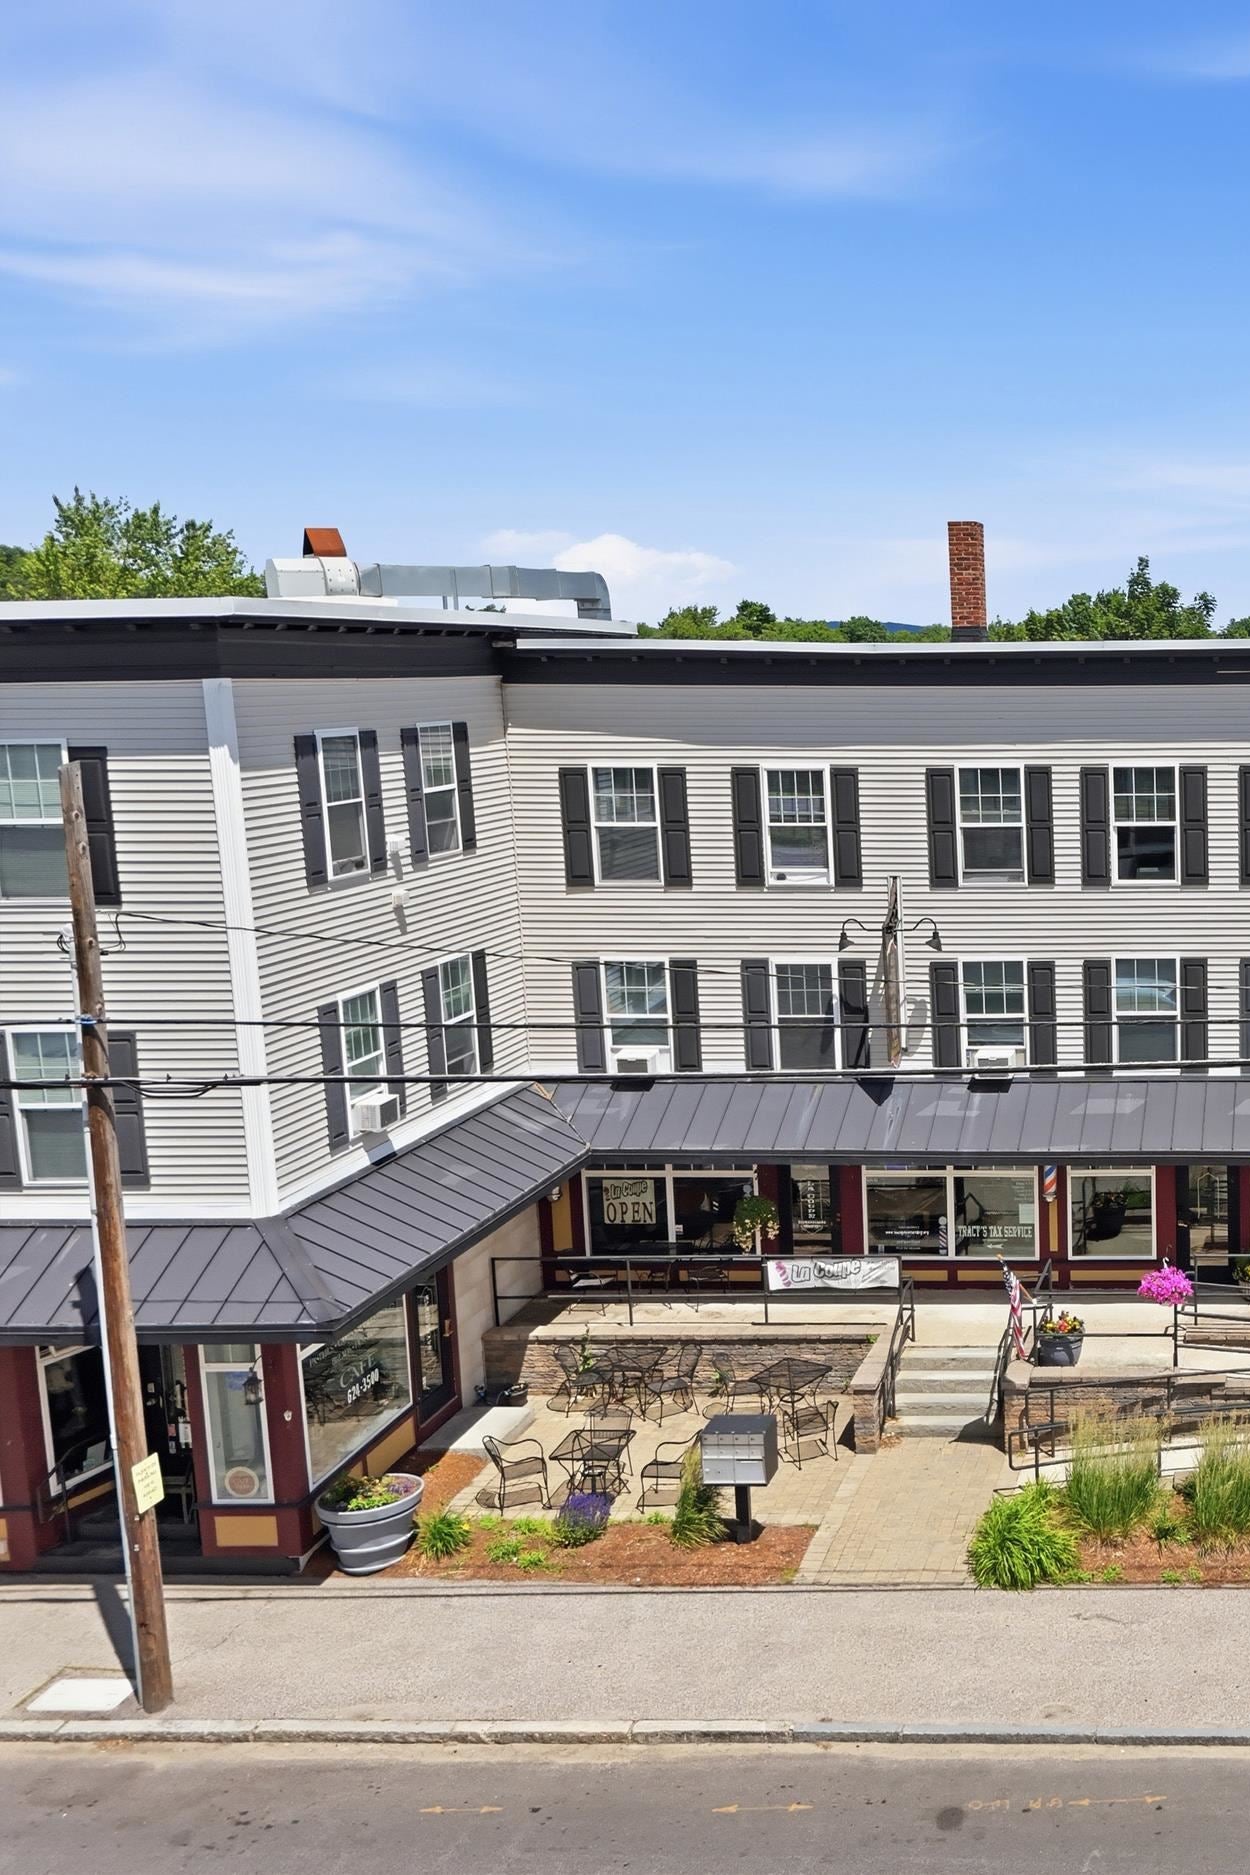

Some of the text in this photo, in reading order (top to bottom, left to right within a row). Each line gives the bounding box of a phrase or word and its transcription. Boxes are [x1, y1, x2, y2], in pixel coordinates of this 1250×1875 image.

[606, 1202, 653, 1223] OPEN
[957, 1225, 1033, 1238] TRACY'S TAX SERVICE
